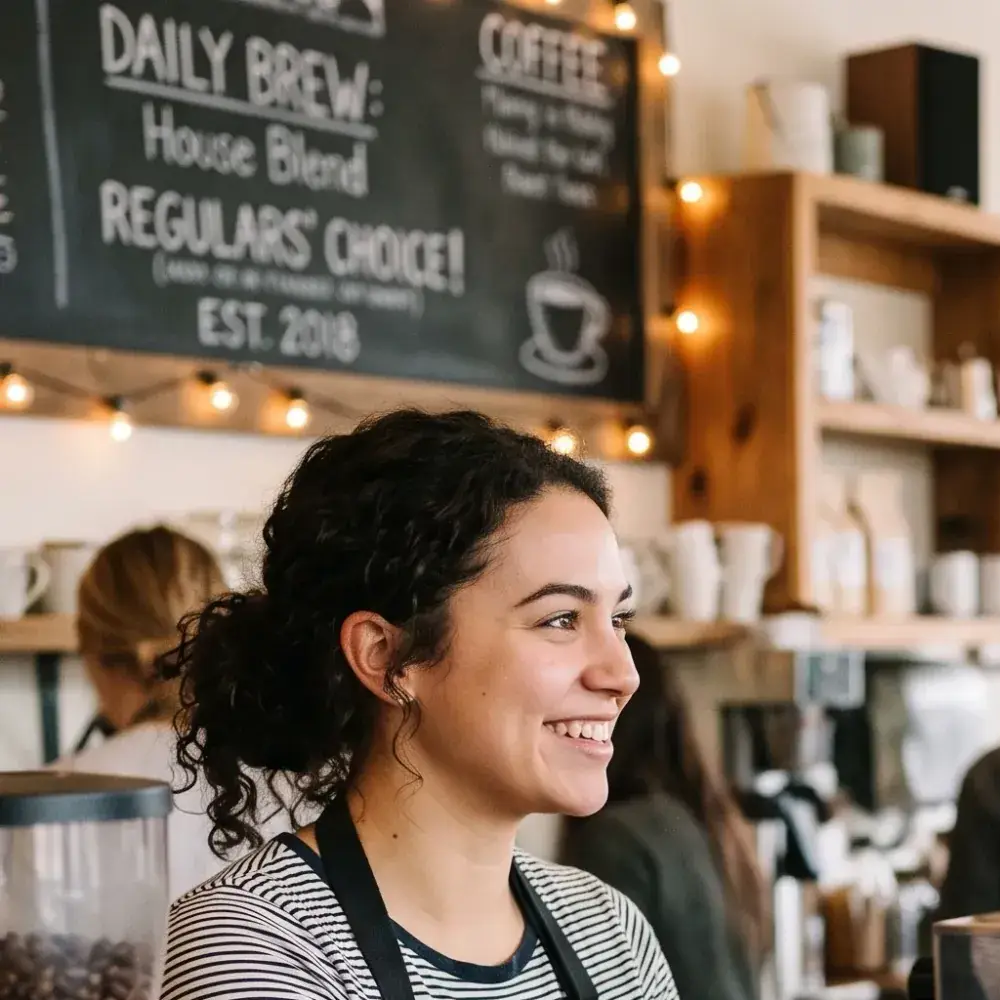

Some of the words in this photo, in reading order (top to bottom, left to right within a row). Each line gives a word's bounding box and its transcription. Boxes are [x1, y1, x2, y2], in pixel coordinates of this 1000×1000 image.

[99, 3, 234, 96] DAILY
[245, 35, 385, 122] BREW:
[478, 12, 608, 90] COFFEE
[142, 100, 258, 179] House
[265, 122, 369, 197] Blend
[99, 179, 319, 271] REGULARS'
[323, 216, 465, 297] CHOICE!
[196, 296, 275, 351] EST.
[279, 304, 362, 364] 2018
